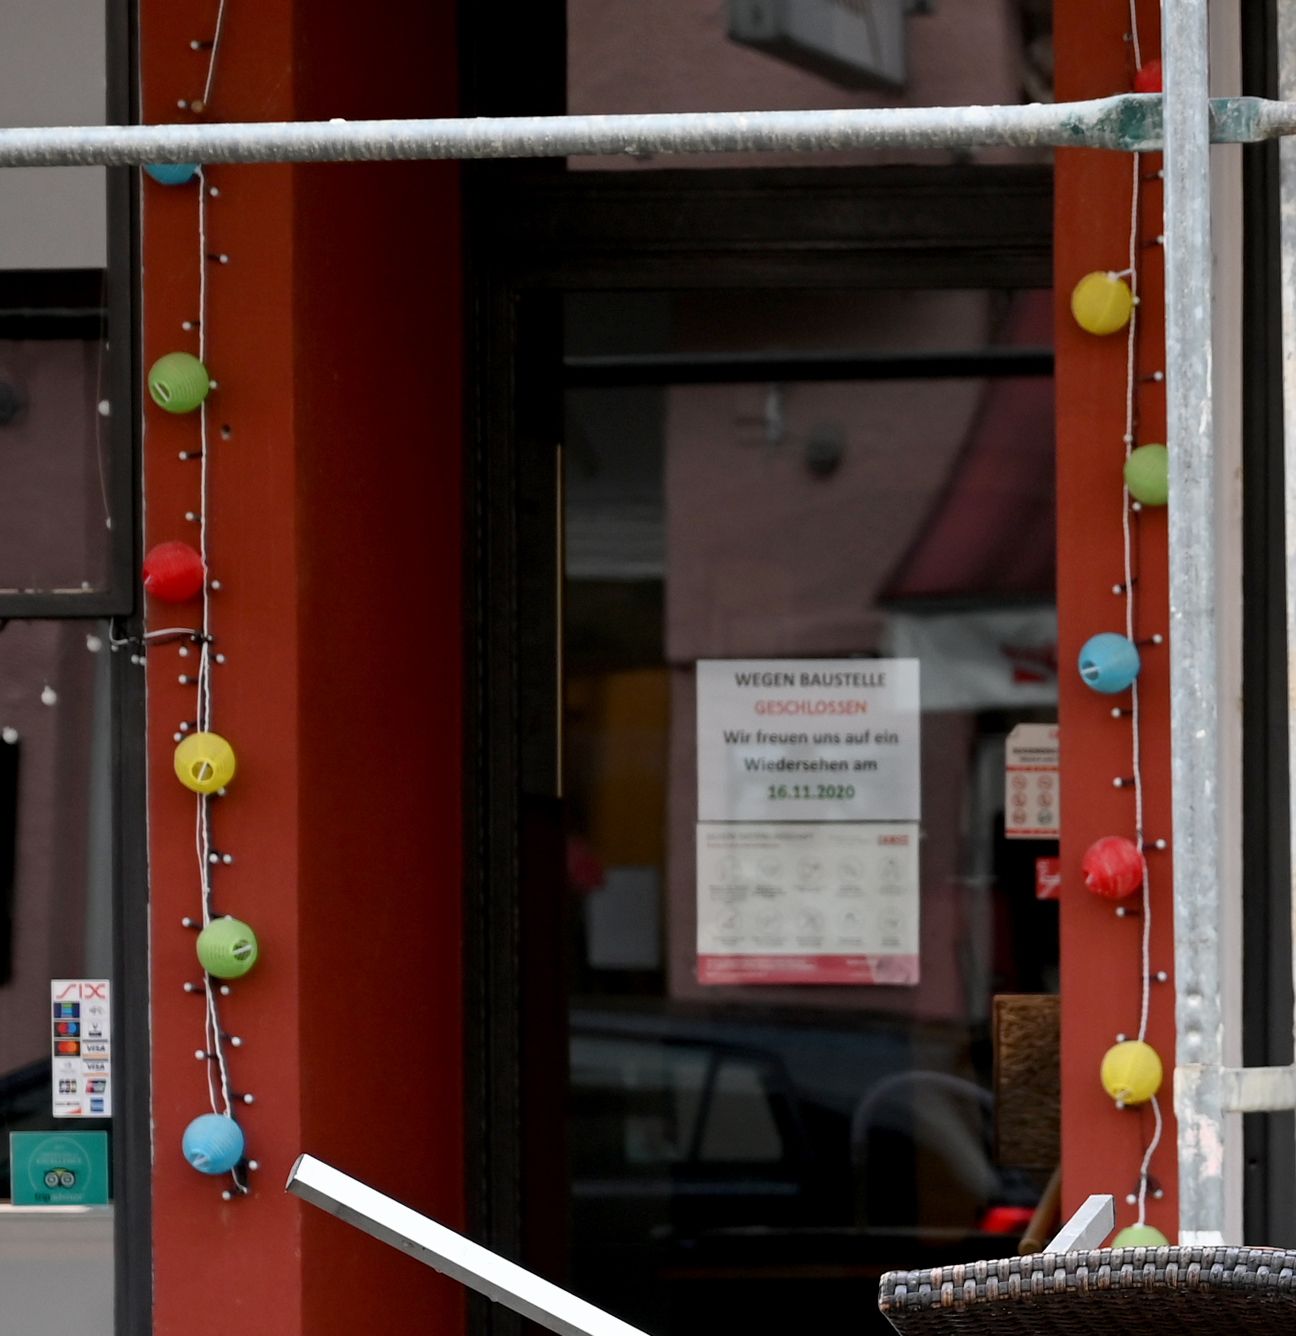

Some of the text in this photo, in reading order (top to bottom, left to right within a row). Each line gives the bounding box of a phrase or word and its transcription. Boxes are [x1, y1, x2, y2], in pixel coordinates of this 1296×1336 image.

[734, 672, 887, 688] WEGEN BAUSTELLE
[754, 699, 868, 715] GESCHLOSSEN
[723, 729, 900, 744] Wir freuen uns auf ein
[744, 757, 878, 771] Wiedersehen am
[768, 784, 856, 800] 16.11.2020
